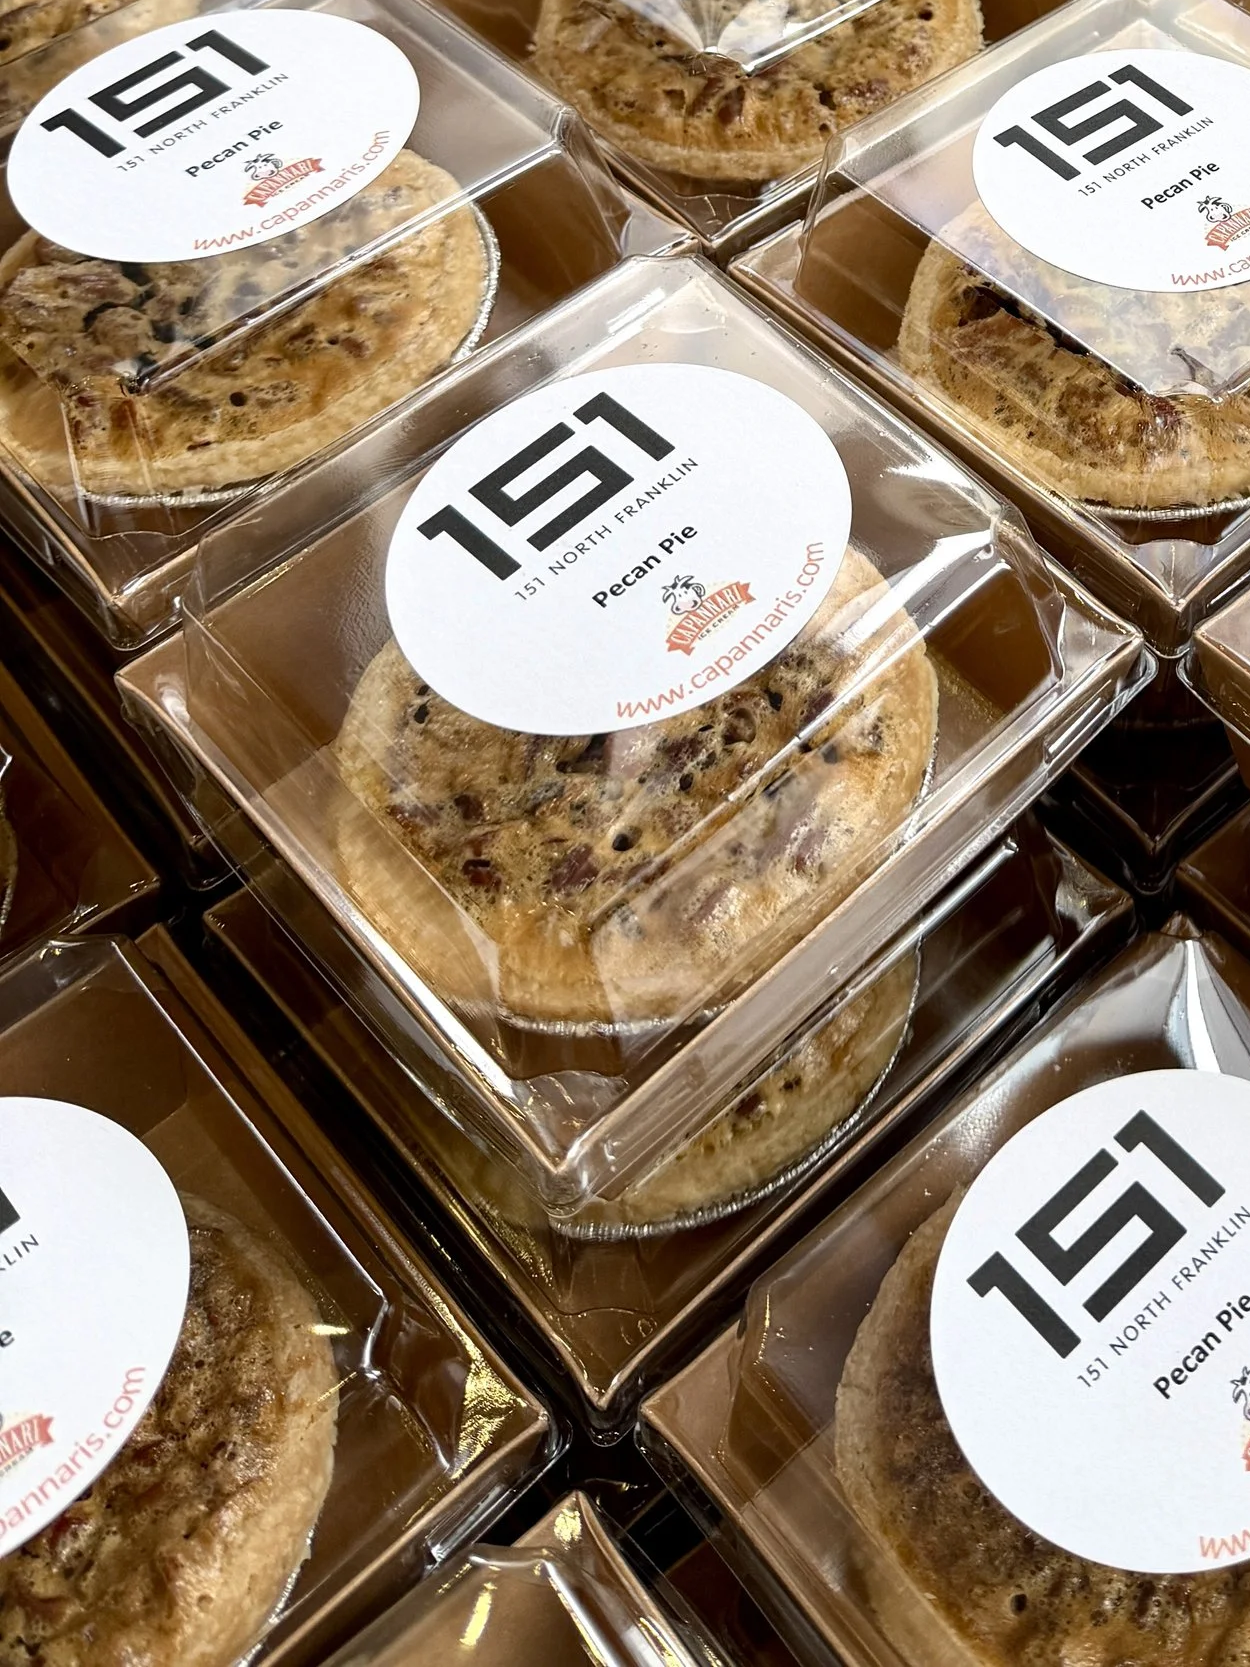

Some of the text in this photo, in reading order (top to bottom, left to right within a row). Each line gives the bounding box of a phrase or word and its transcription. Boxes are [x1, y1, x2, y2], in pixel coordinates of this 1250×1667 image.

[41, 30, 268, 158] 151
[119, 73, 289, 172] 151 NORTH FRANKLIN
[994, 65, 1193, 180] 151
[185, 121, 282, 178] Pecan Pie
[193, 130, 390, 252] www.capannaris.com
[1080, 115, 1213, 197] 151 NORTH FRANKLIN
[1141, 163, 1219, 210] Pecan Pie
[417, 392, 674, 580] 151
[516, 459, 696, 599] 151 NORTH FRANKLIN
[591, 526, 697, 608] Pecan Pie
[670, 584, 742, 645] CAPANNARI
[616, 541, 825, 719] www.capannaris.com
[967, 1110, 1225, 1359] 151
[1078, 1358, 1108, 1387] 151
[1110, 1292, 1171, 1355] NORTH
[1153, 1332, 1221, 1399] Pecan
